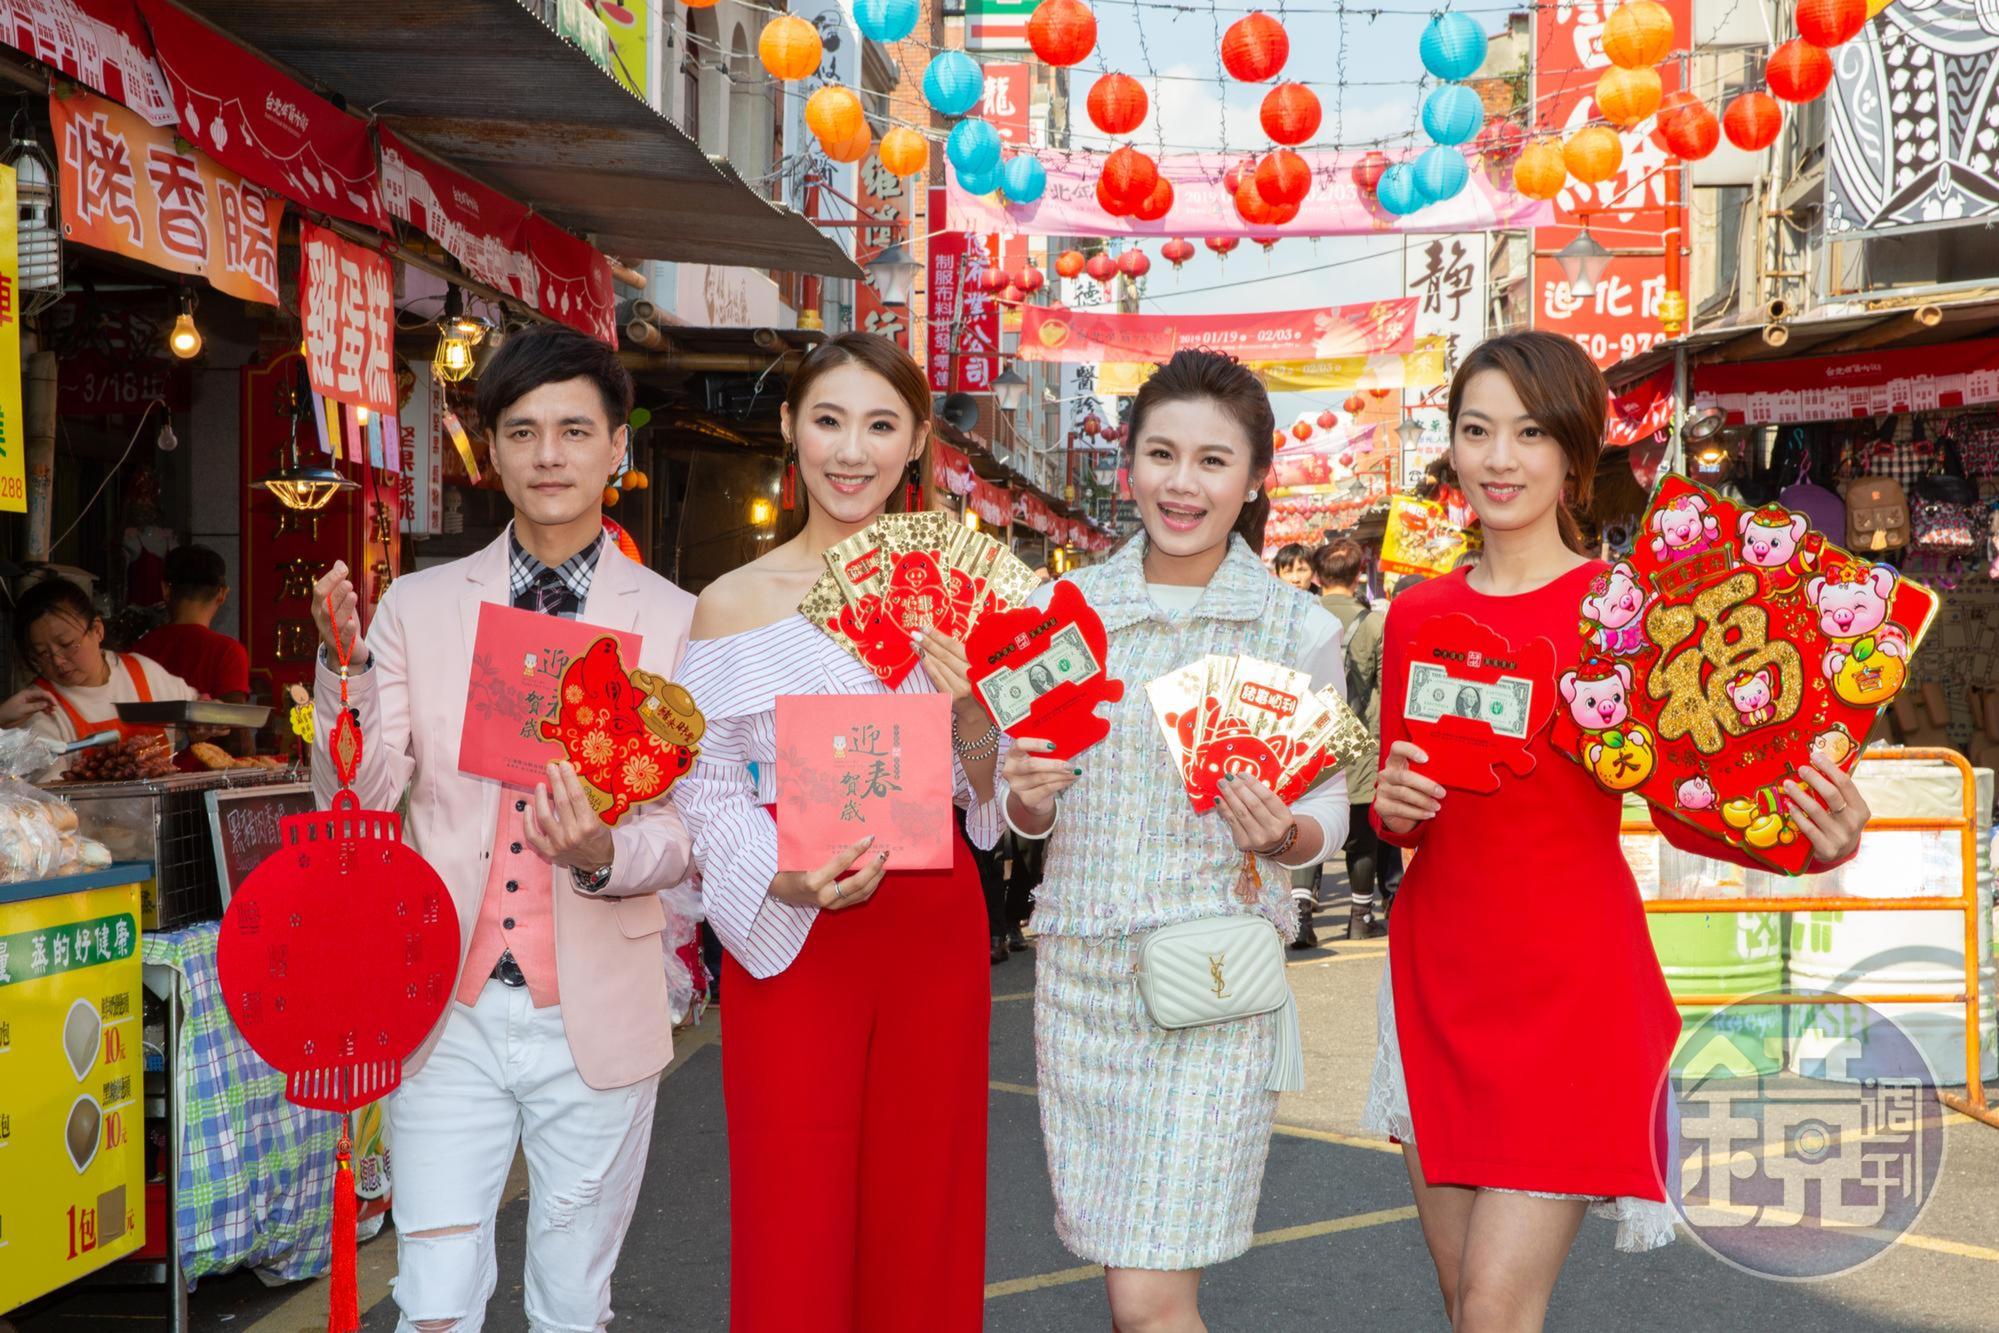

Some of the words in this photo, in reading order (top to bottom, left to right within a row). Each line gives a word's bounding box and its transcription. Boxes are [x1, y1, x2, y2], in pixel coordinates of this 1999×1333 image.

[65, 112, 280, 298] 烤香腸
[306, 241, 391, 405] 雞蛋糕
[1179, 333, 1200, 344] 2019
[1203, 330, 1238, 344] 01/19
[1257, 328, 1292, 342] 02/03
[1645, 571, 1803, 756] 福
[848, 724, 903, 799] 迎春
[1612, 752, 1641, 776] 大
[31, 918, 130, 974] 蒸的好健康
